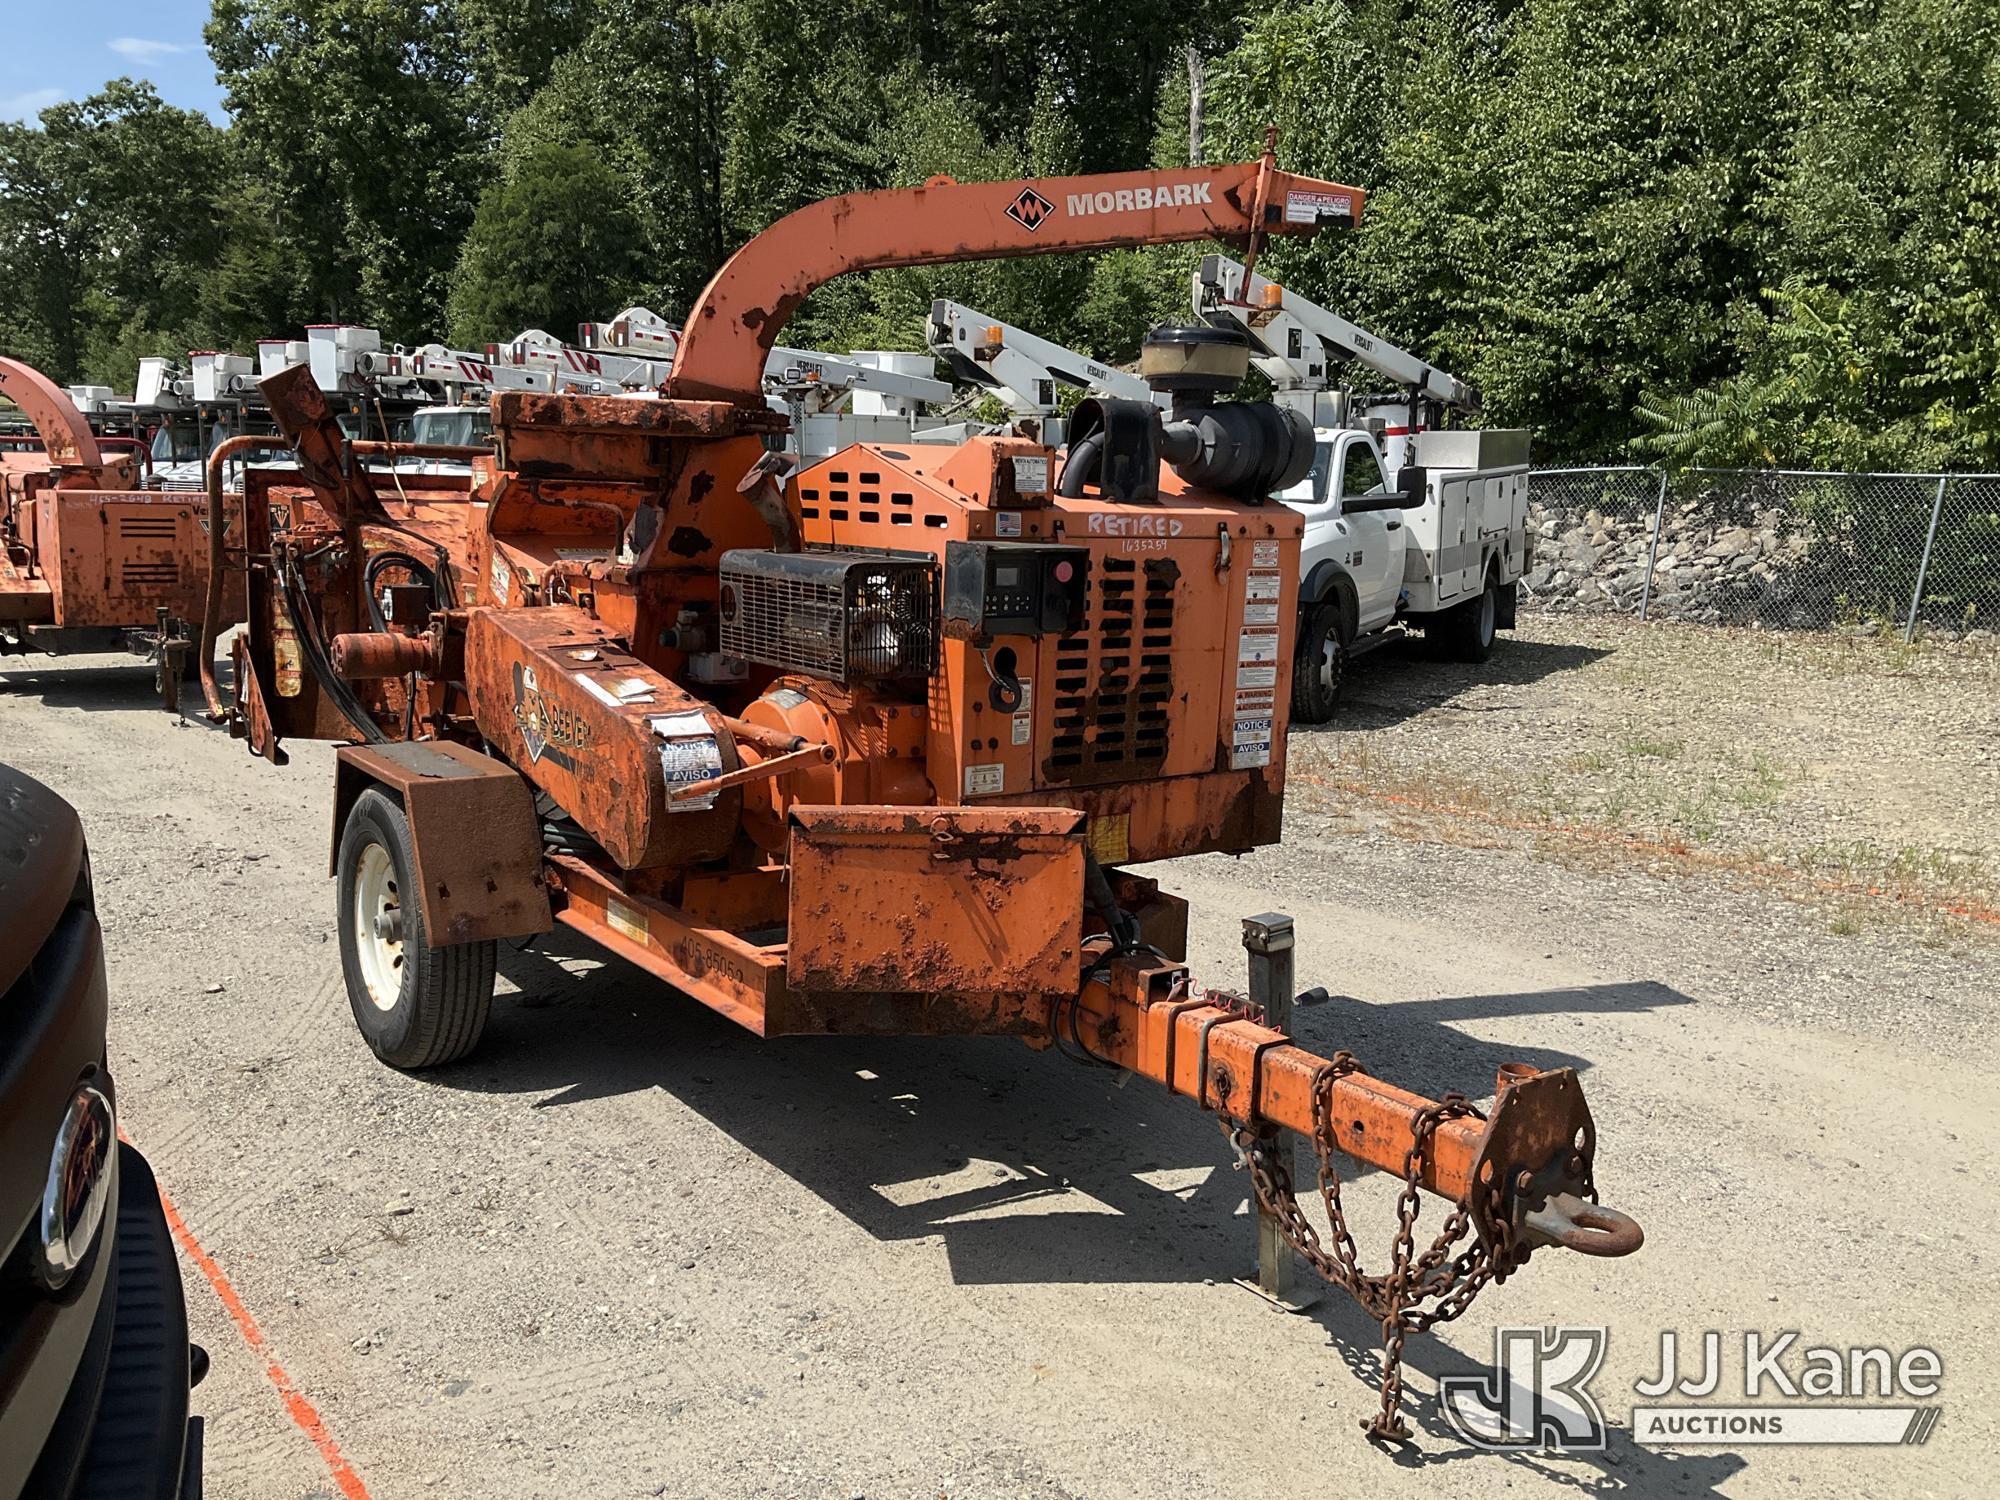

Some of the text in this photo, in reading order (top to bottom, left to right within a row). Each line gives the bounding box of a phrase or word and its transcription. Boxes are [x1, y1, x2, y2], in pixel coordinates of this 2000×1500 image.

[1066, 182, 1213, 217] MORBARK
[1289, 193, 1317, 203] DANGER
[1322, 196, 1350, 206] PELIGRO
[162, 496, 208, 504] RETIRE
[192, 505, 240, 517] Veeer
[1088, 512, 1184, 537] RETIRED
[1121, 539, 1168, 553] 1635259
[1237, 720, 1268, 730] NOTICE
[1238, 743, 1265, 753] AVISO
[673, 769, 711, 781] AVISO
